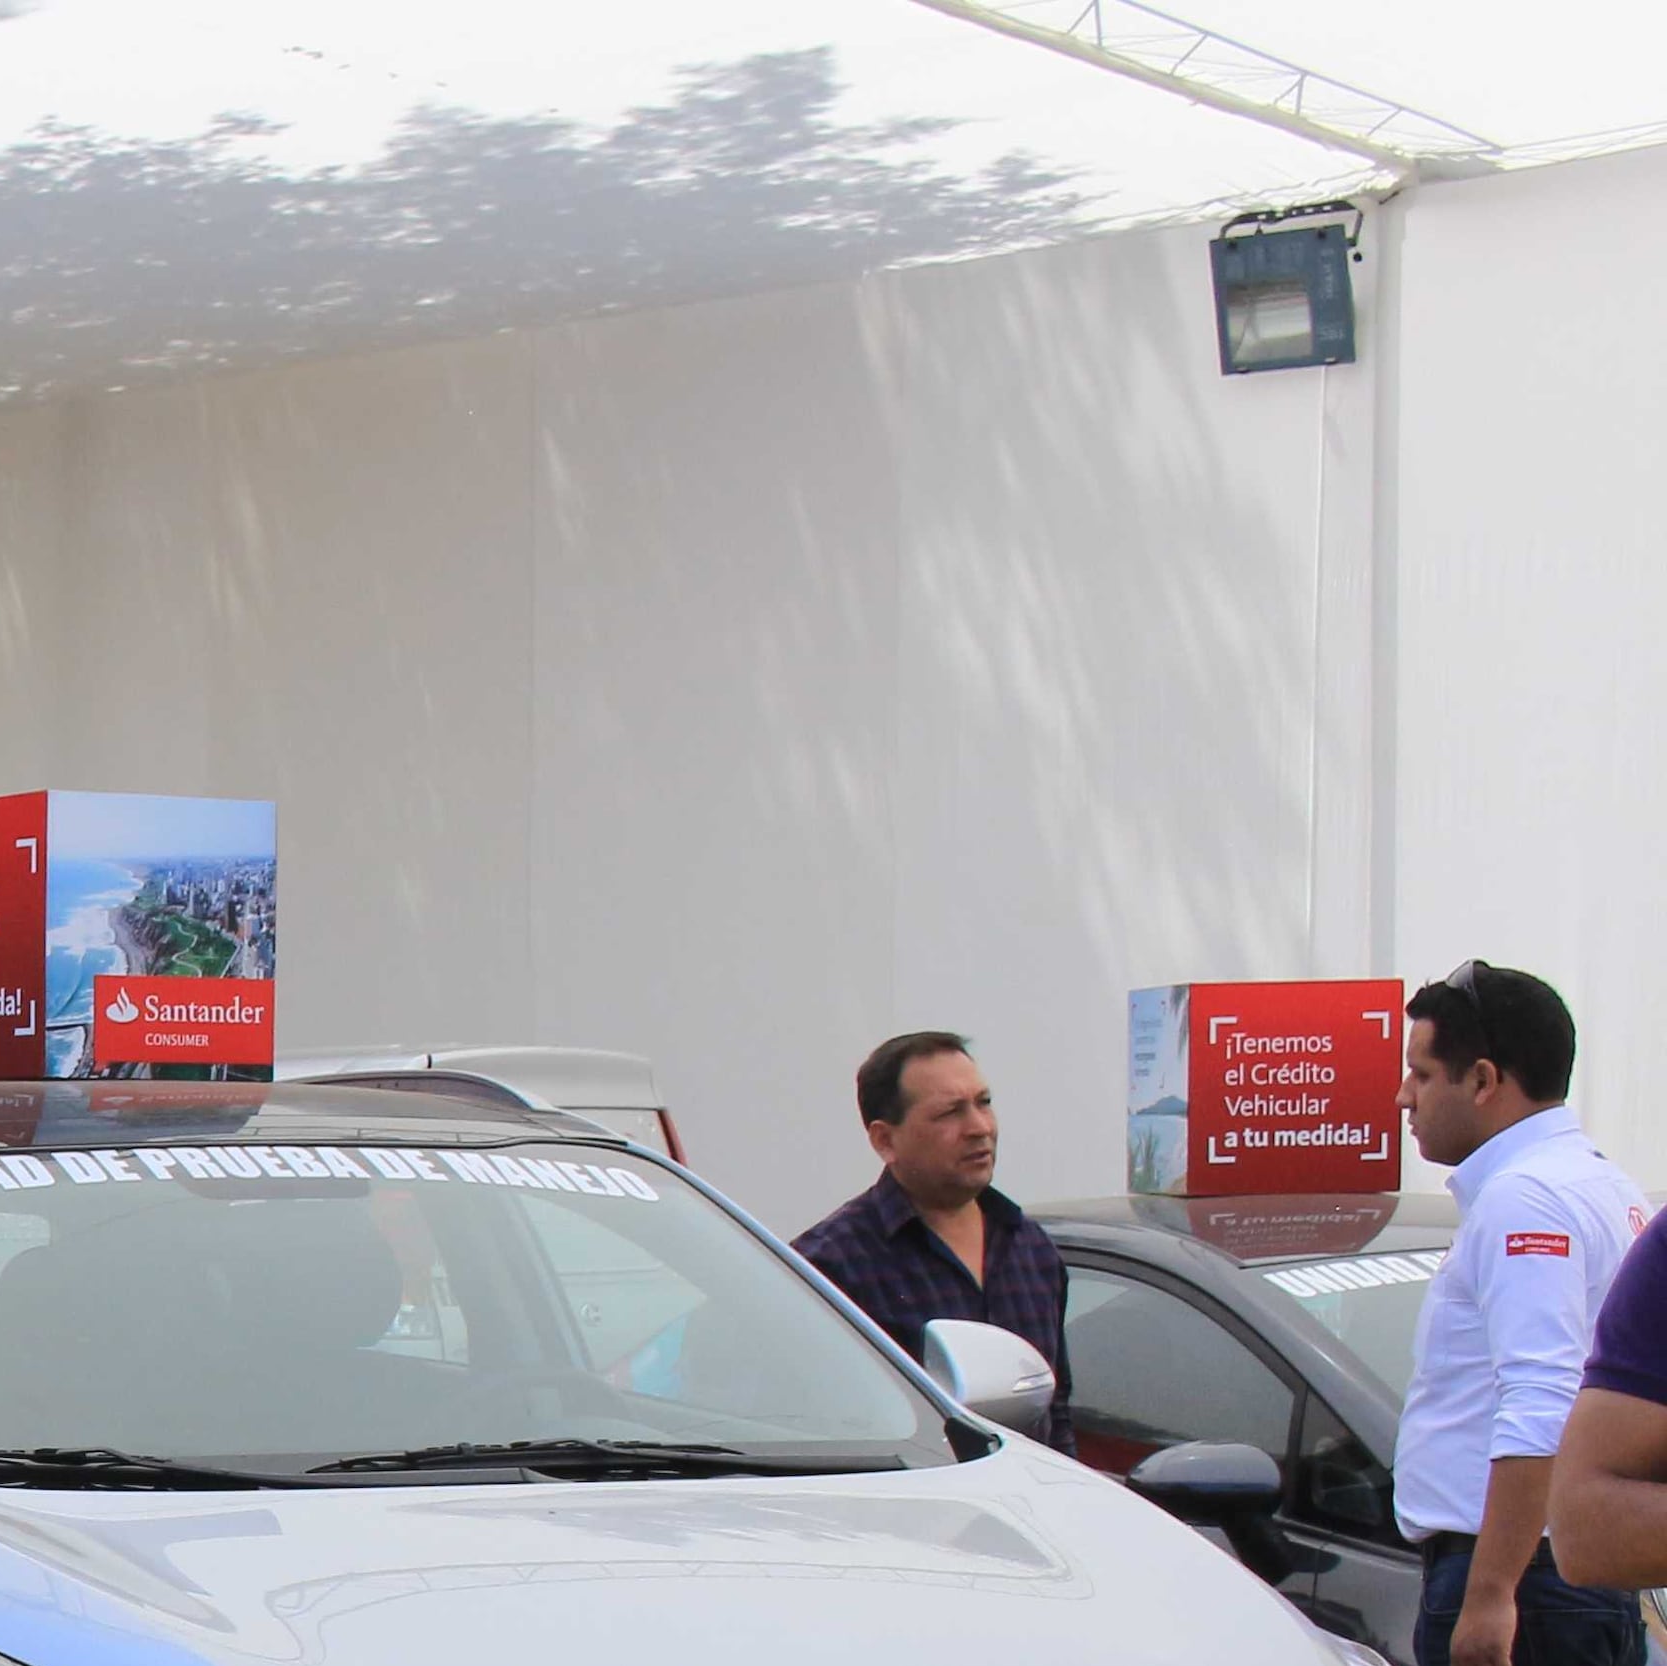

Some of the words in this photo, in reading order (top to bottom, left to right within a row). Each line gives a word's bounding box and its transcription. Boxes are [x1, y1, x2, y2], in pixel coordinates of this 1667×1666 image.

[144, 993, 266, 1026] Santander
[144, 1032, 210, 1048] CONSUMER
[1225, 1032, 1333, 1060] ¡Tenemos
[1224, 1062, 1244, 1086] el
[1250, 1061, 1336, 1085] Crédito
[1223, 1092, 1330, 1117] Vehicular
[1224, 1130, 1238, 1148] a
[1243, 1127, 1269, 1147] tu
[1274, 1122, 1371, 1147] medida!
[50, 1148, 142, 1185] DE
[132, 1145, 372, 1180] PRUEBA
[358, 1147, 451, 1182] DE
[434, 1150, 660, 1202] MANEJO
[1262, 1255, 1433, 1298] UNIDAD
